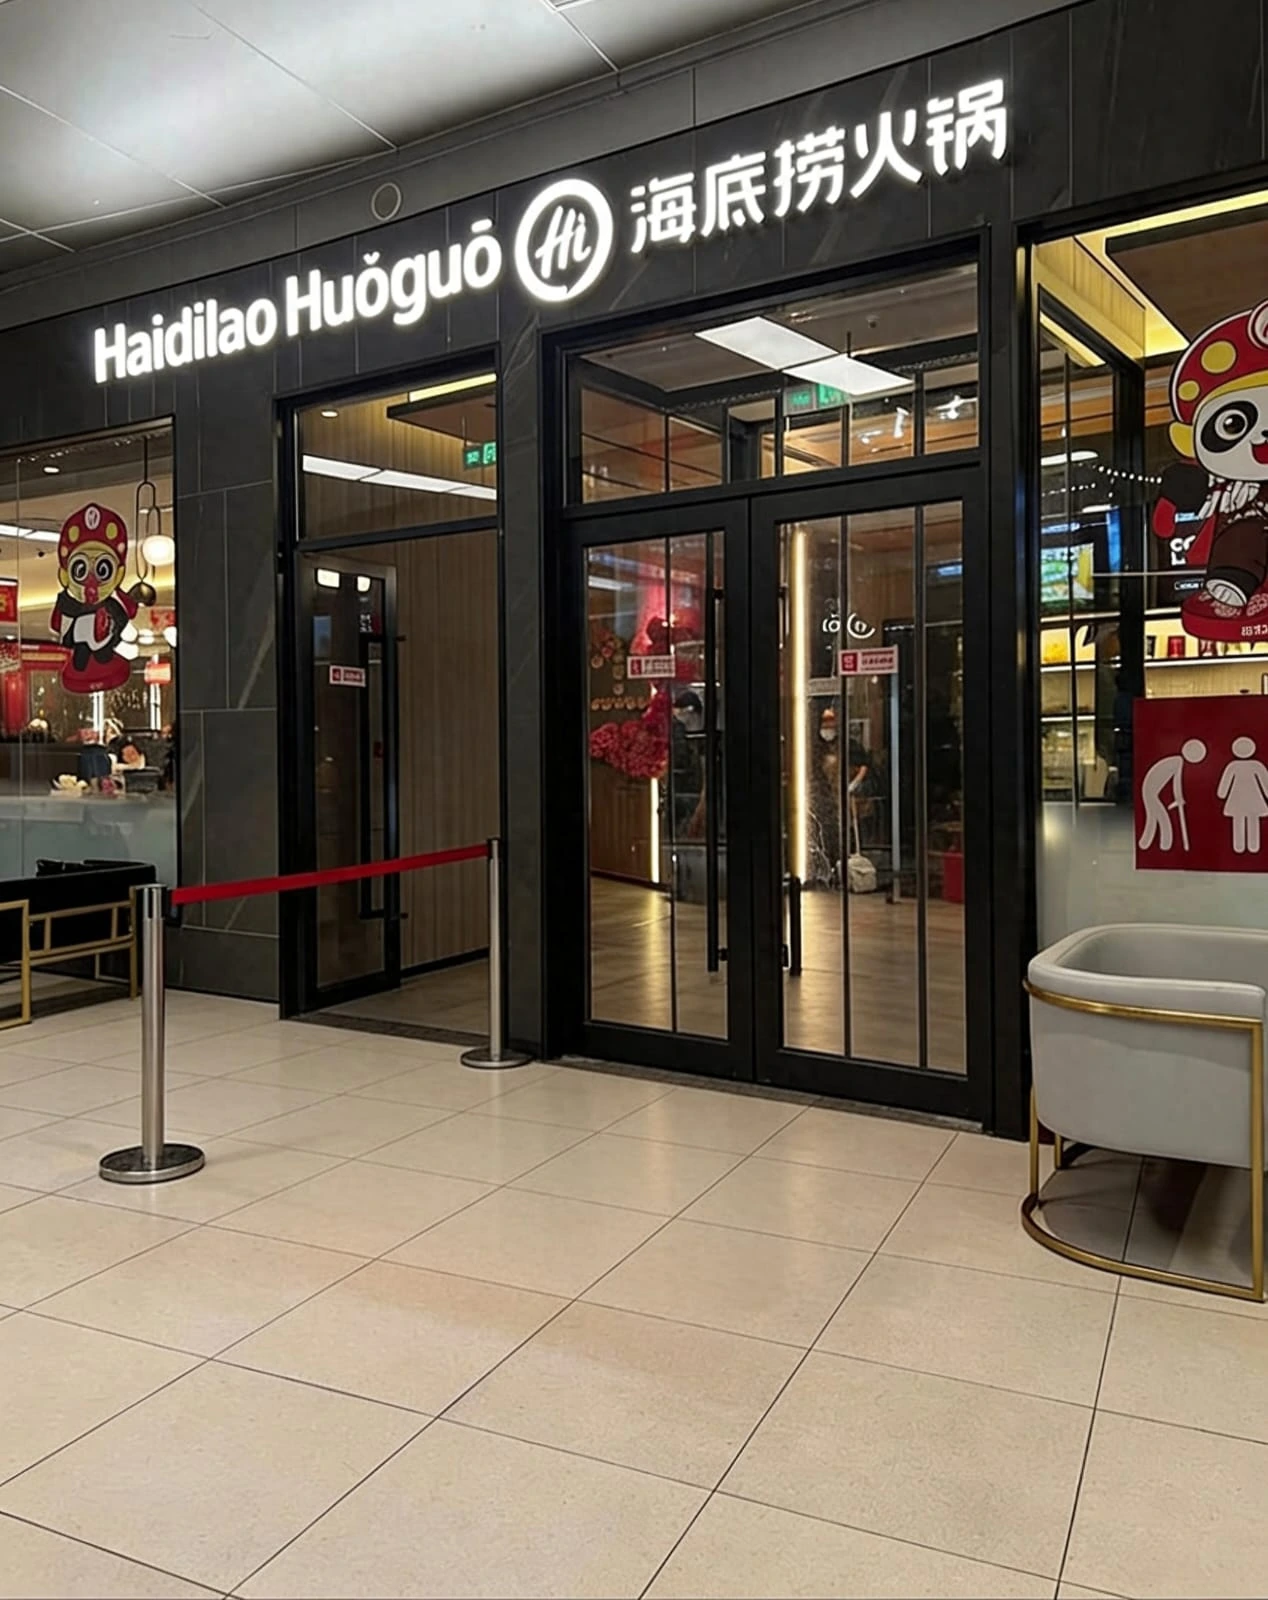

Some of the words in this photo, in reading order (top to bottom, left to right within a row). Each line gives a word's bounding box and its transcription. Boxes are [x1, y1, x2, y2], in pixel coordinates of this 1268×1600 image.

[630, 78, 1007, 253] 海底捞火锅
[534, 203, 592, 280] Hi
[93, 298, 278, 384] Haidilao
